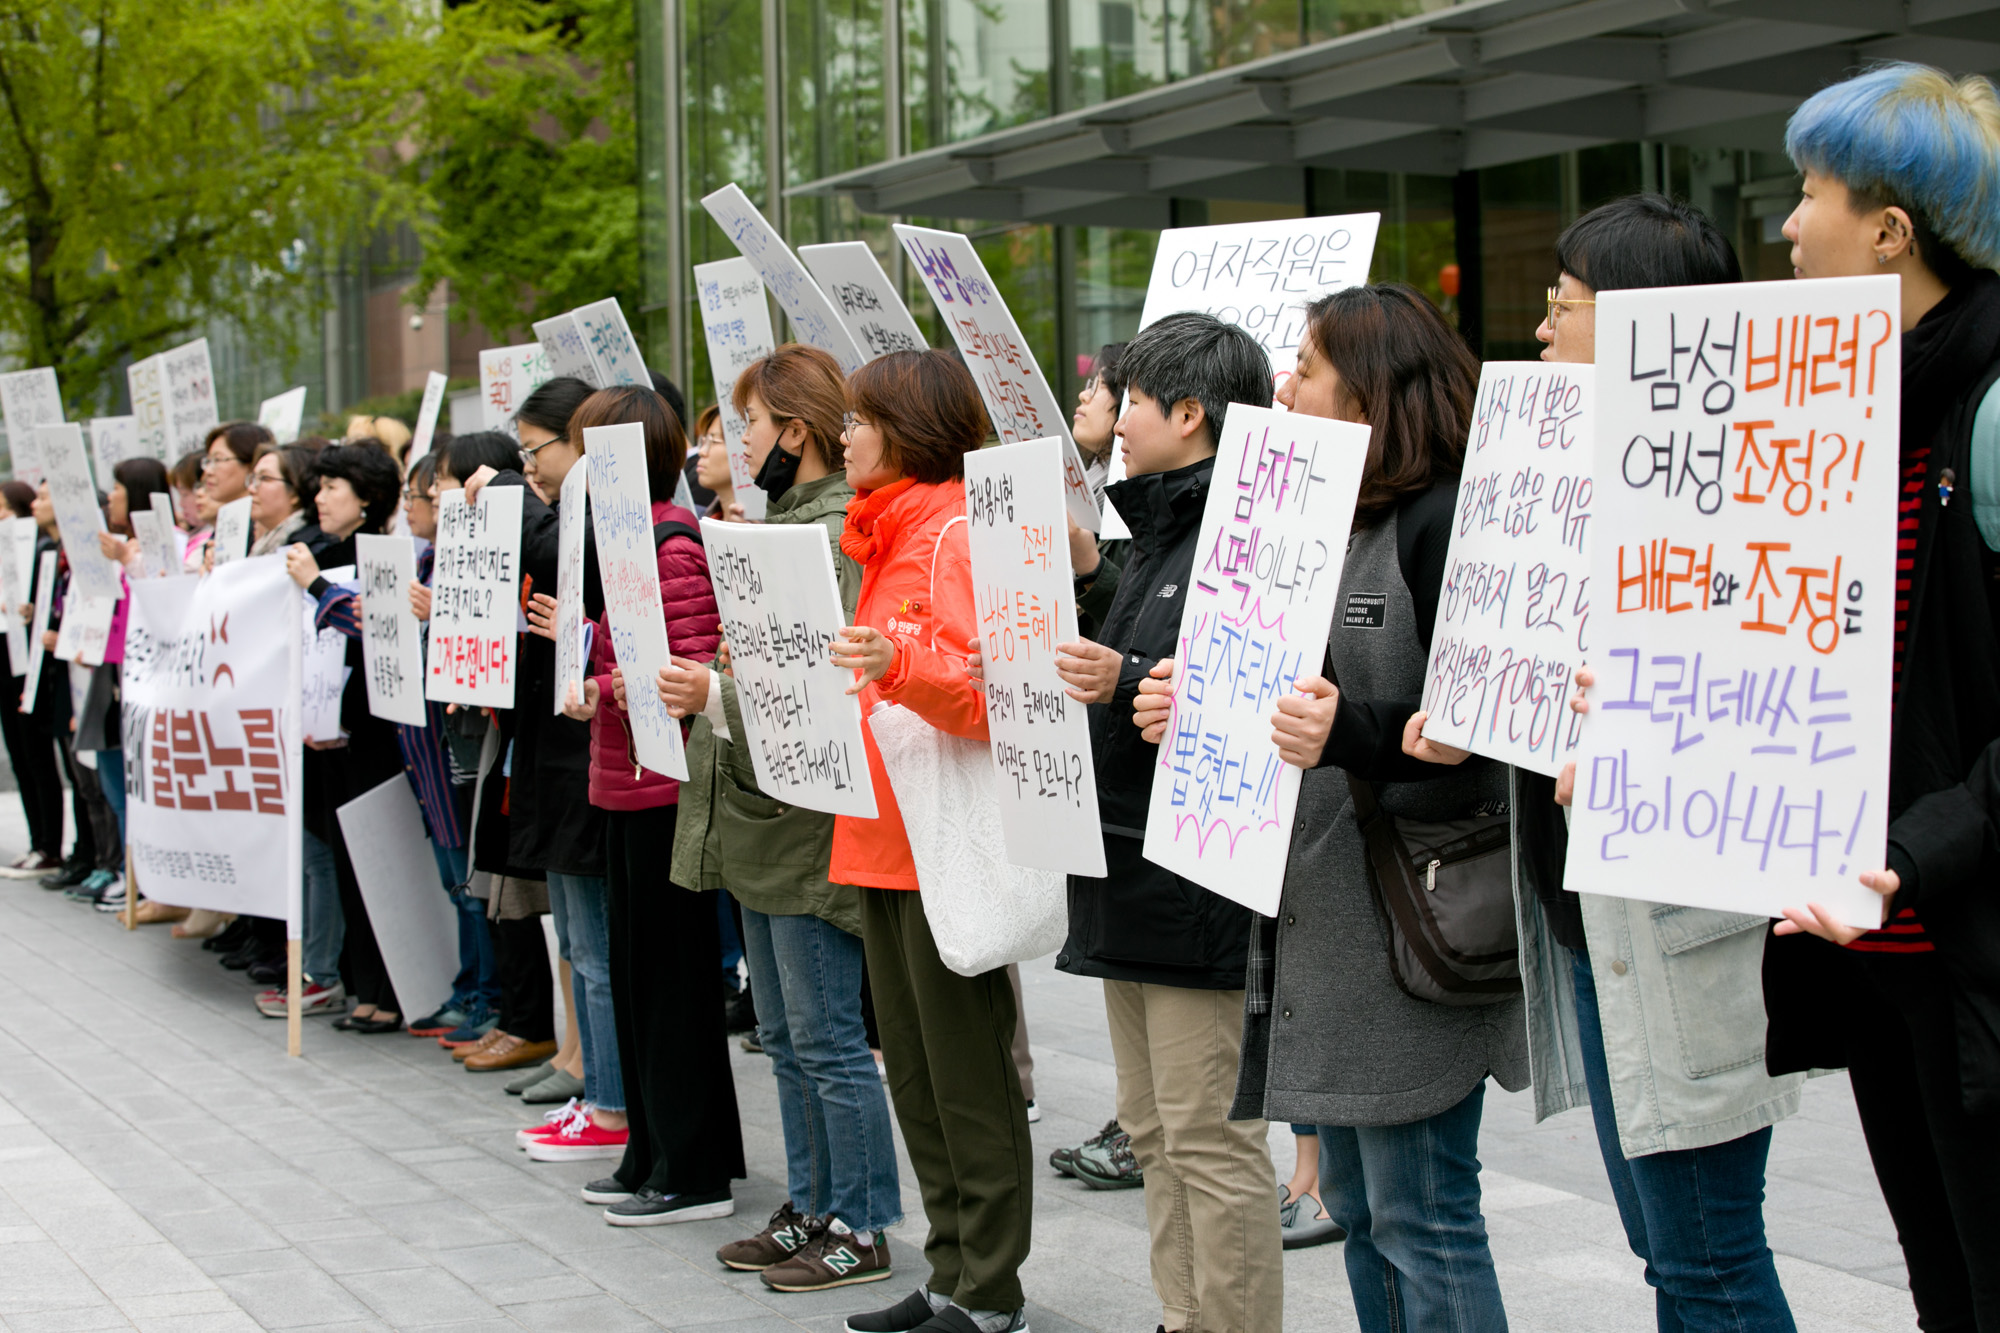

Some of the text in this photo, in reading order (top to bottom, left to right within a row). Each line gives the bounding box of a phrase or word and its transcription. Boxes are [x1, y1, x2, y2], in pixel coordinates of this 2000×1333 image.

[1172, 229, 1351, 292] 여자직원은
[1519, 376, 1542, 427] 더
[1234, 426, 1326, 524] 남자가
[1021, 525, 1053, 572] 조작!
[1197, 526, 1328, 610] 스펙이냐?
[897, 621, 922, 636] 민중당
[989, 682, 1066, 724] 무엇이 문제인지
[997, 741, 1082, 808] 아직도 모르나?
